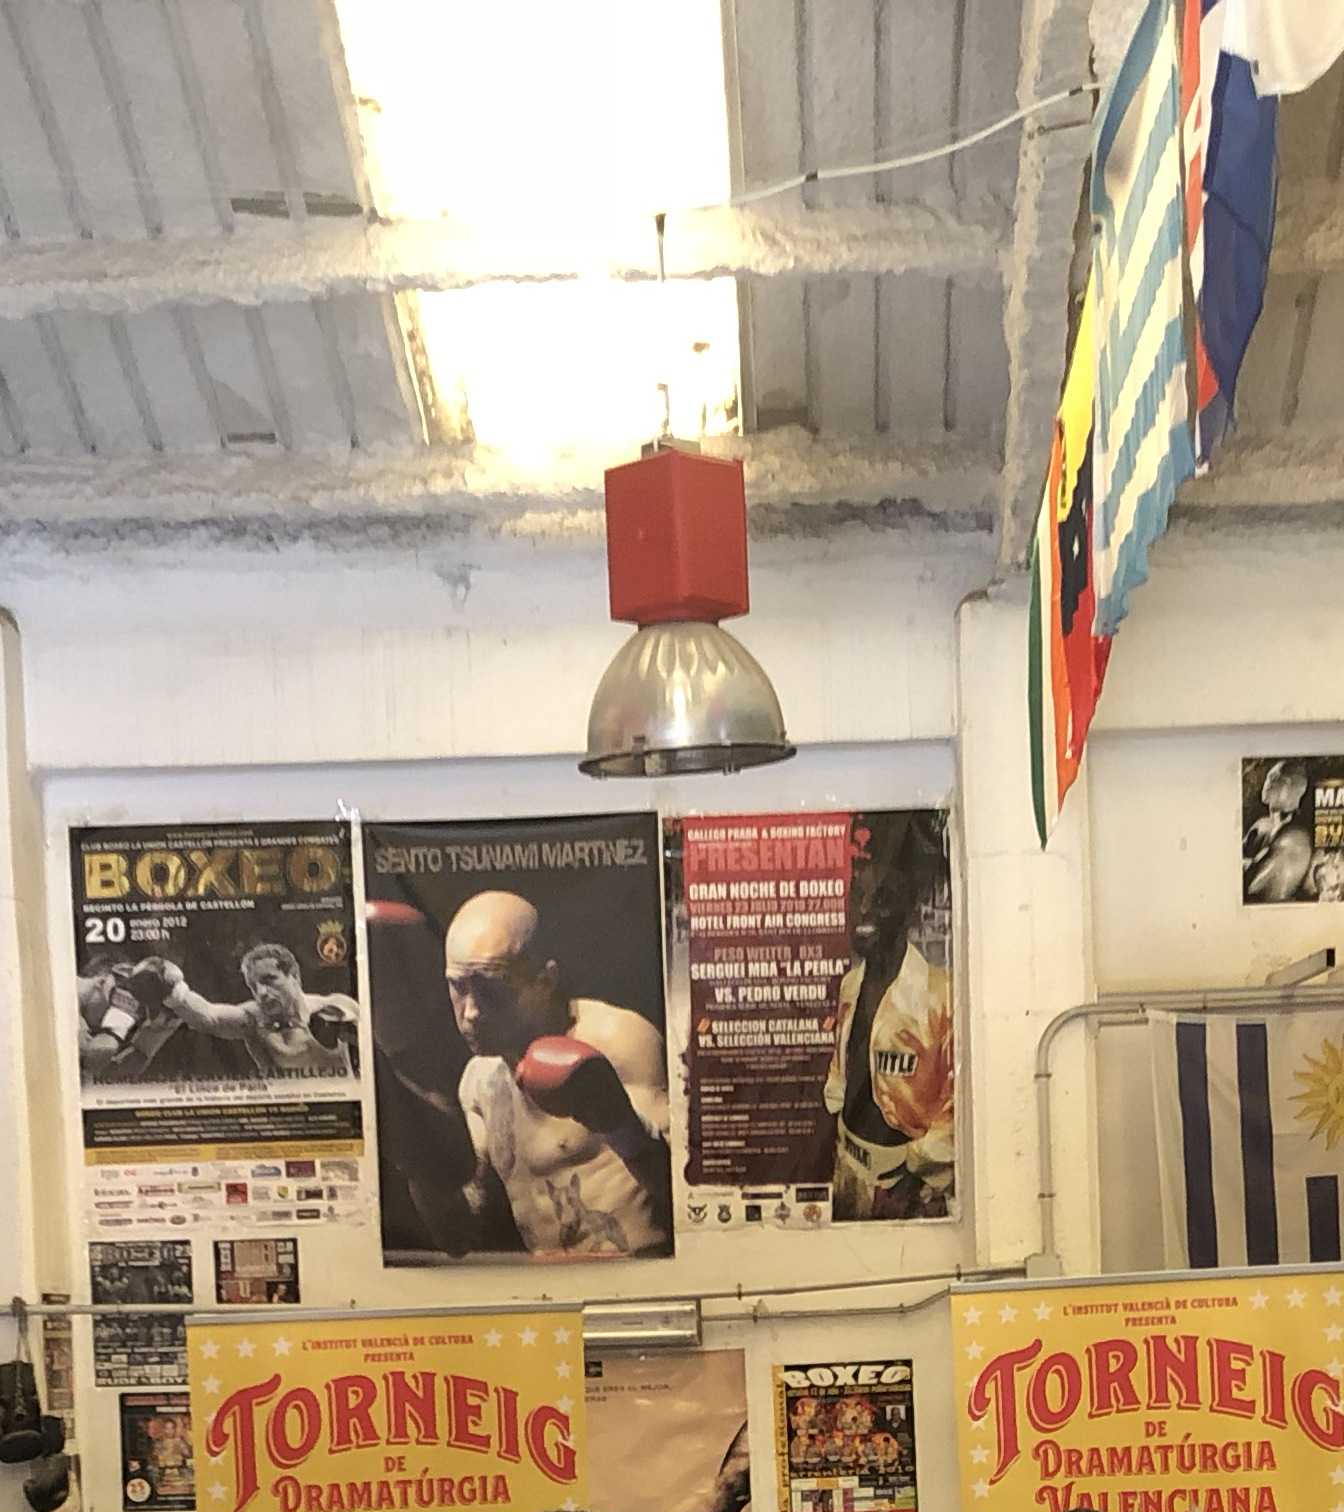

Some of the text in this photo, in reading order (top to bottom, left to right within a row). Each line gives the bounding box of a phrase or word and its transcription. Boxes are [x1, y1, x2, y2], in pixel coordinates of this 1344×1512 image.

[770, 826, 805, 839] BOXING
[807, 824, 846, 838] FACTORY
[375, 847, 442, 873] SENTO
[446, 843, 538, 873] TSUNAMI
[689, 840, 844, 871] PRESENTAN
[84, 848, 340, 899] BOXEO
[689, 879, 844, 900] GRAN NOCHE DE BOXEO
[85, 917, 125, 943] 20
[691, 912, 846, 930] HOTEL FRONT AIR CONGRESS
[714, 946, 744, 961] PESO
[746, 945, 792, 960] WELTER
[691, 962, 746, 979] SERGUEI
[804, 958, 850, 976] PERLA"
[714, 987, 736, 1003] VS.
[739, 985, 781, 1002] PEDRO
[768, 1017, 819, 1033] CATALANA
[698, 1034, 715, 1048] VS.
[773, 1030, 835, 1046] VALENCIANA
[1063, 1296, 1239, 1316] L'INSTITUT VALENCIÀ DE CULTURA
[1124, 1315, 1177, 1328] PRESENTA
[302, 1333, 474, 1352] L'INSTITUT VALENCIÀ DE CULTURA
[364, 1350, 415, 1364] PRESENTA
[777, 1365, 911, 1389] BOXEO
[1144, 1421, 1167, 1438] DE
[383, 1456, 407, 1474] DE
[1032, 1433, 1277, 1481] DRAMATÚRGIA
